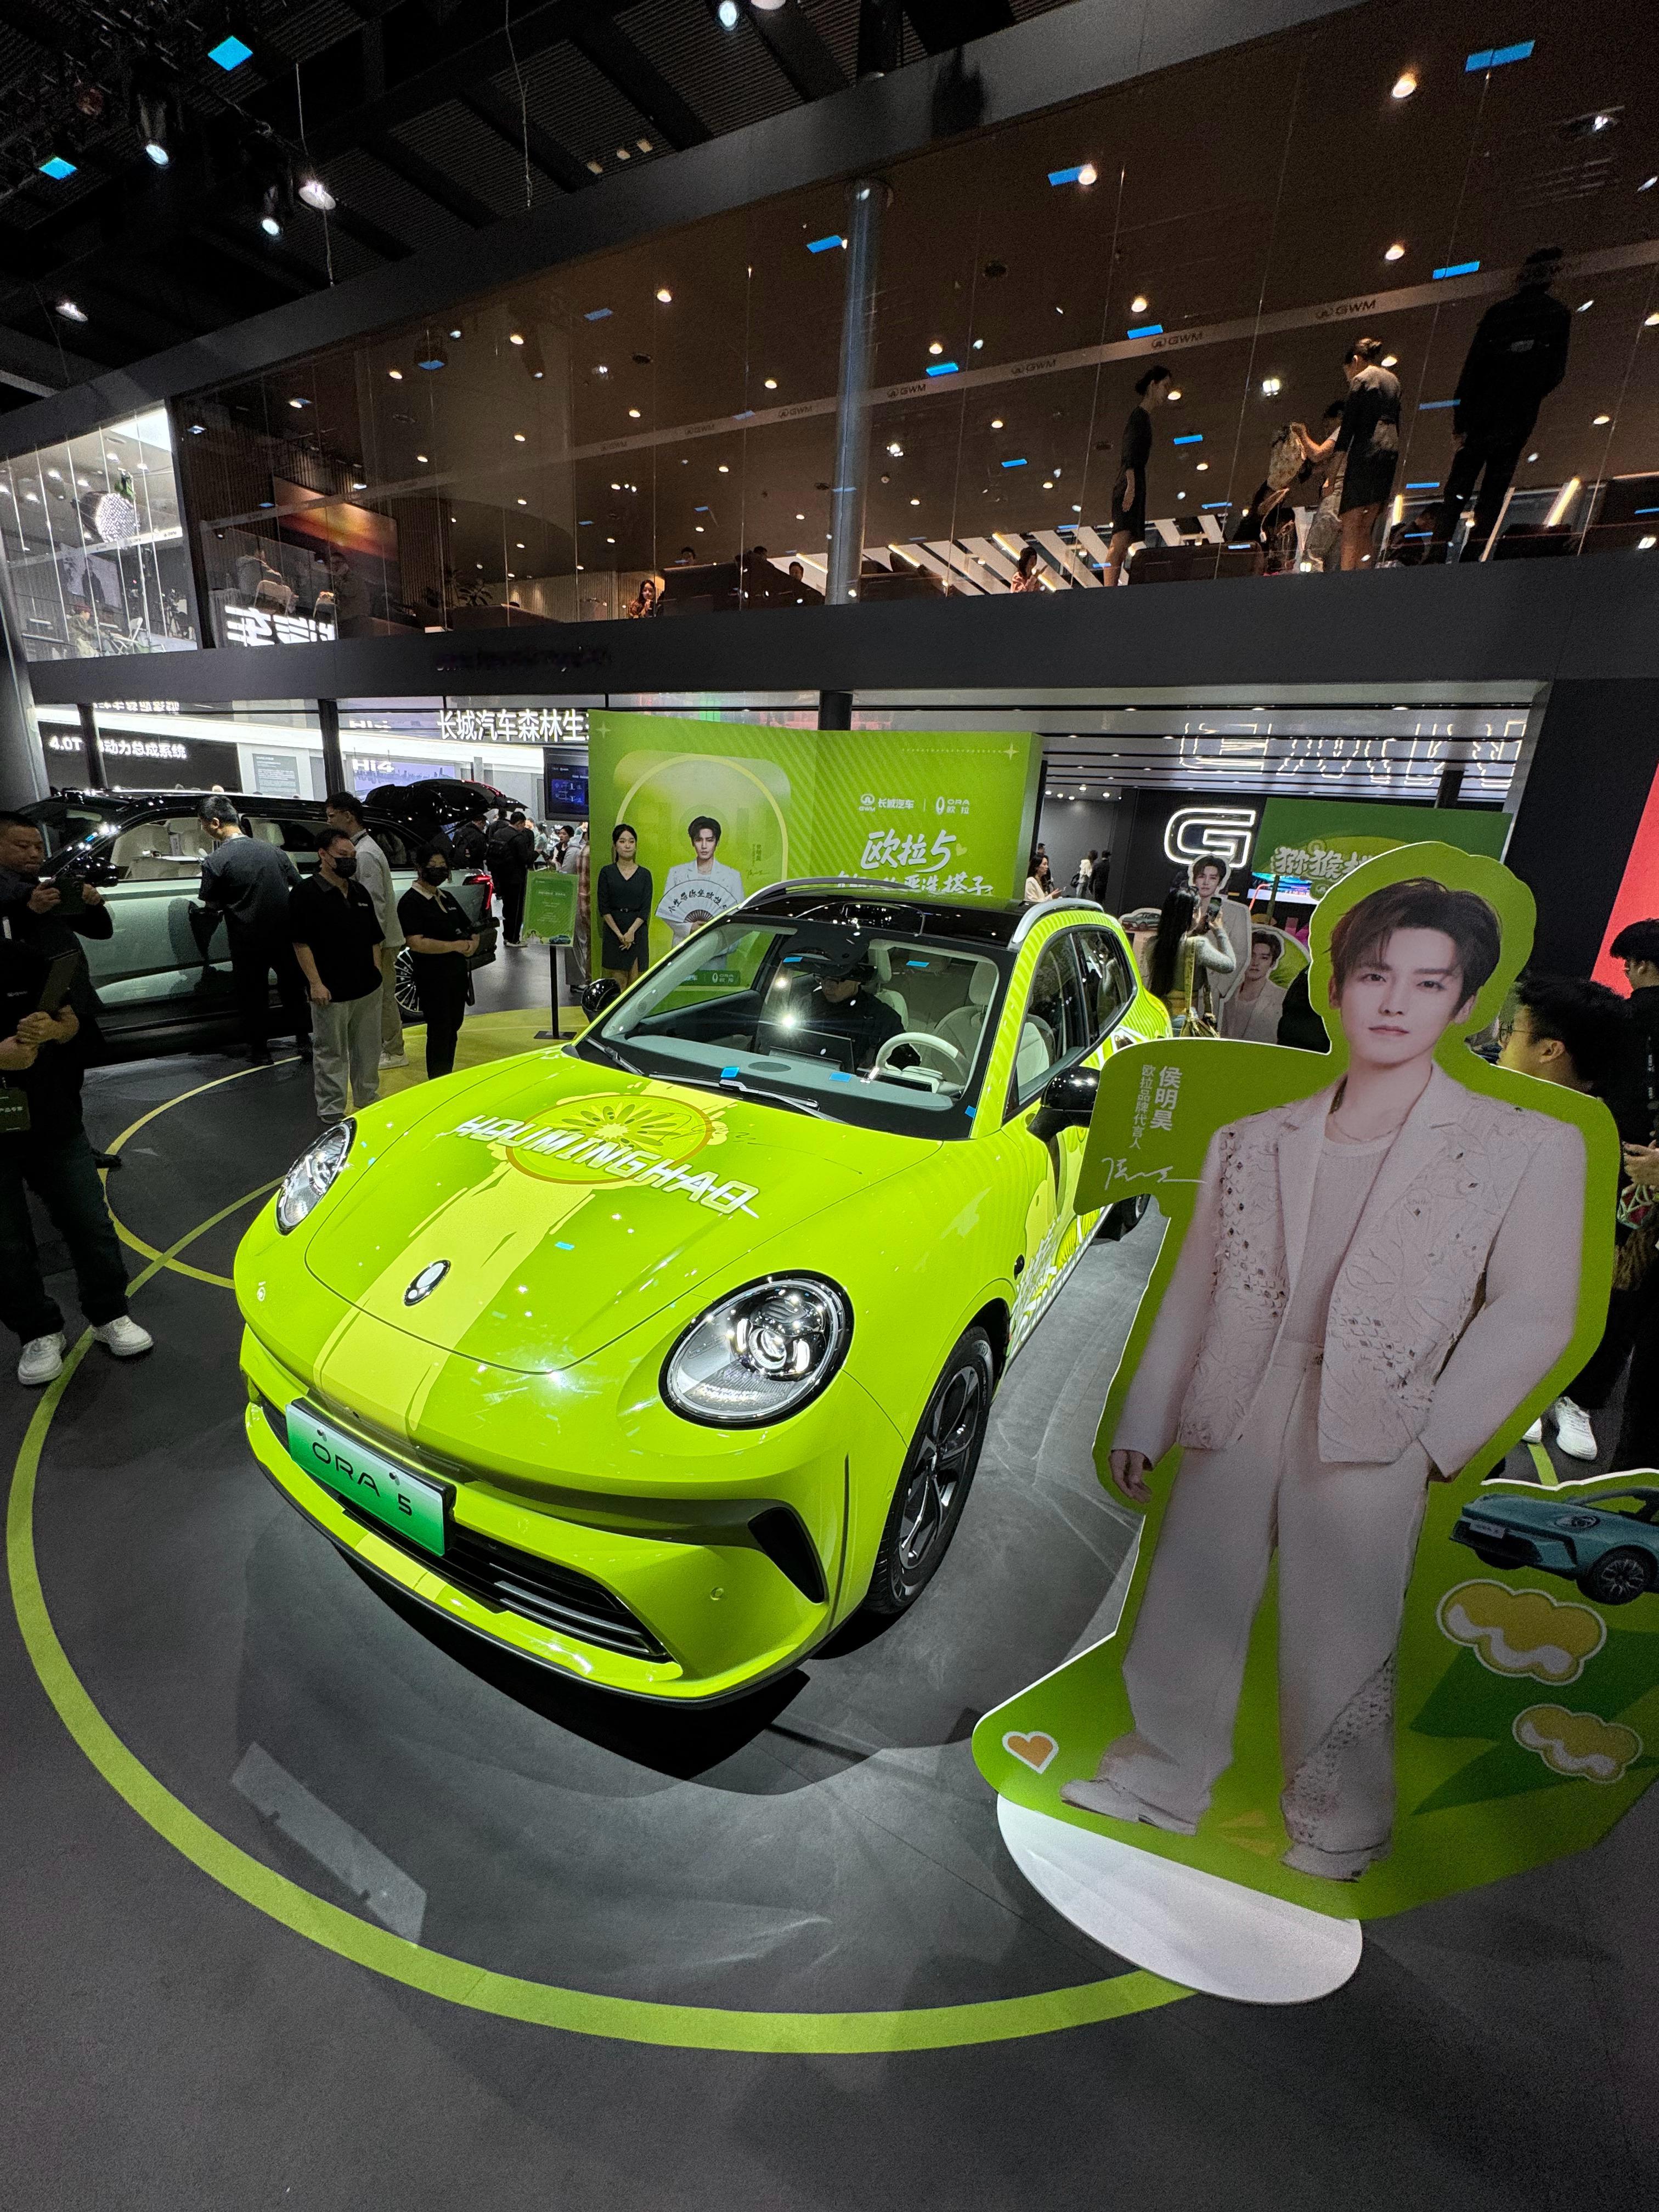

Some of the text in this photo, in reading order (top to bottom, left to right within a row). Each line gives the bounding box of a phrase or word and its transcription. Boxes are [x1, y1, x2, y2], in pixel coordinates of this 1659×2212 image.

[1335, 299, 1376, 315] GWM
[1168, 332, 1203, 345] GWM
[1026, 359, 1057, 371] GWM
[900, 383, 926, 396] GWM
[789, 406, 812, 415] GWM
[437, 709, 589, 742] 长城汽车森林生
[49, 735, 83, 751] 4.0T
[352, 759, 395, 774] Hi4
[878, 798, 915, 810] 长城汽车
[946, 806, 969, 814] 欧拉
[860, 828, 957, 873] 欧拉5
[1149, 1065, 1183, 1131] 侯明昊
[1128, 1064, 1156, 1150] 欧拉品牌代言人
[450, 1114, 760, 1215] HOUMINGHAO
[312, 1442, 412, 1516] ORA 5
